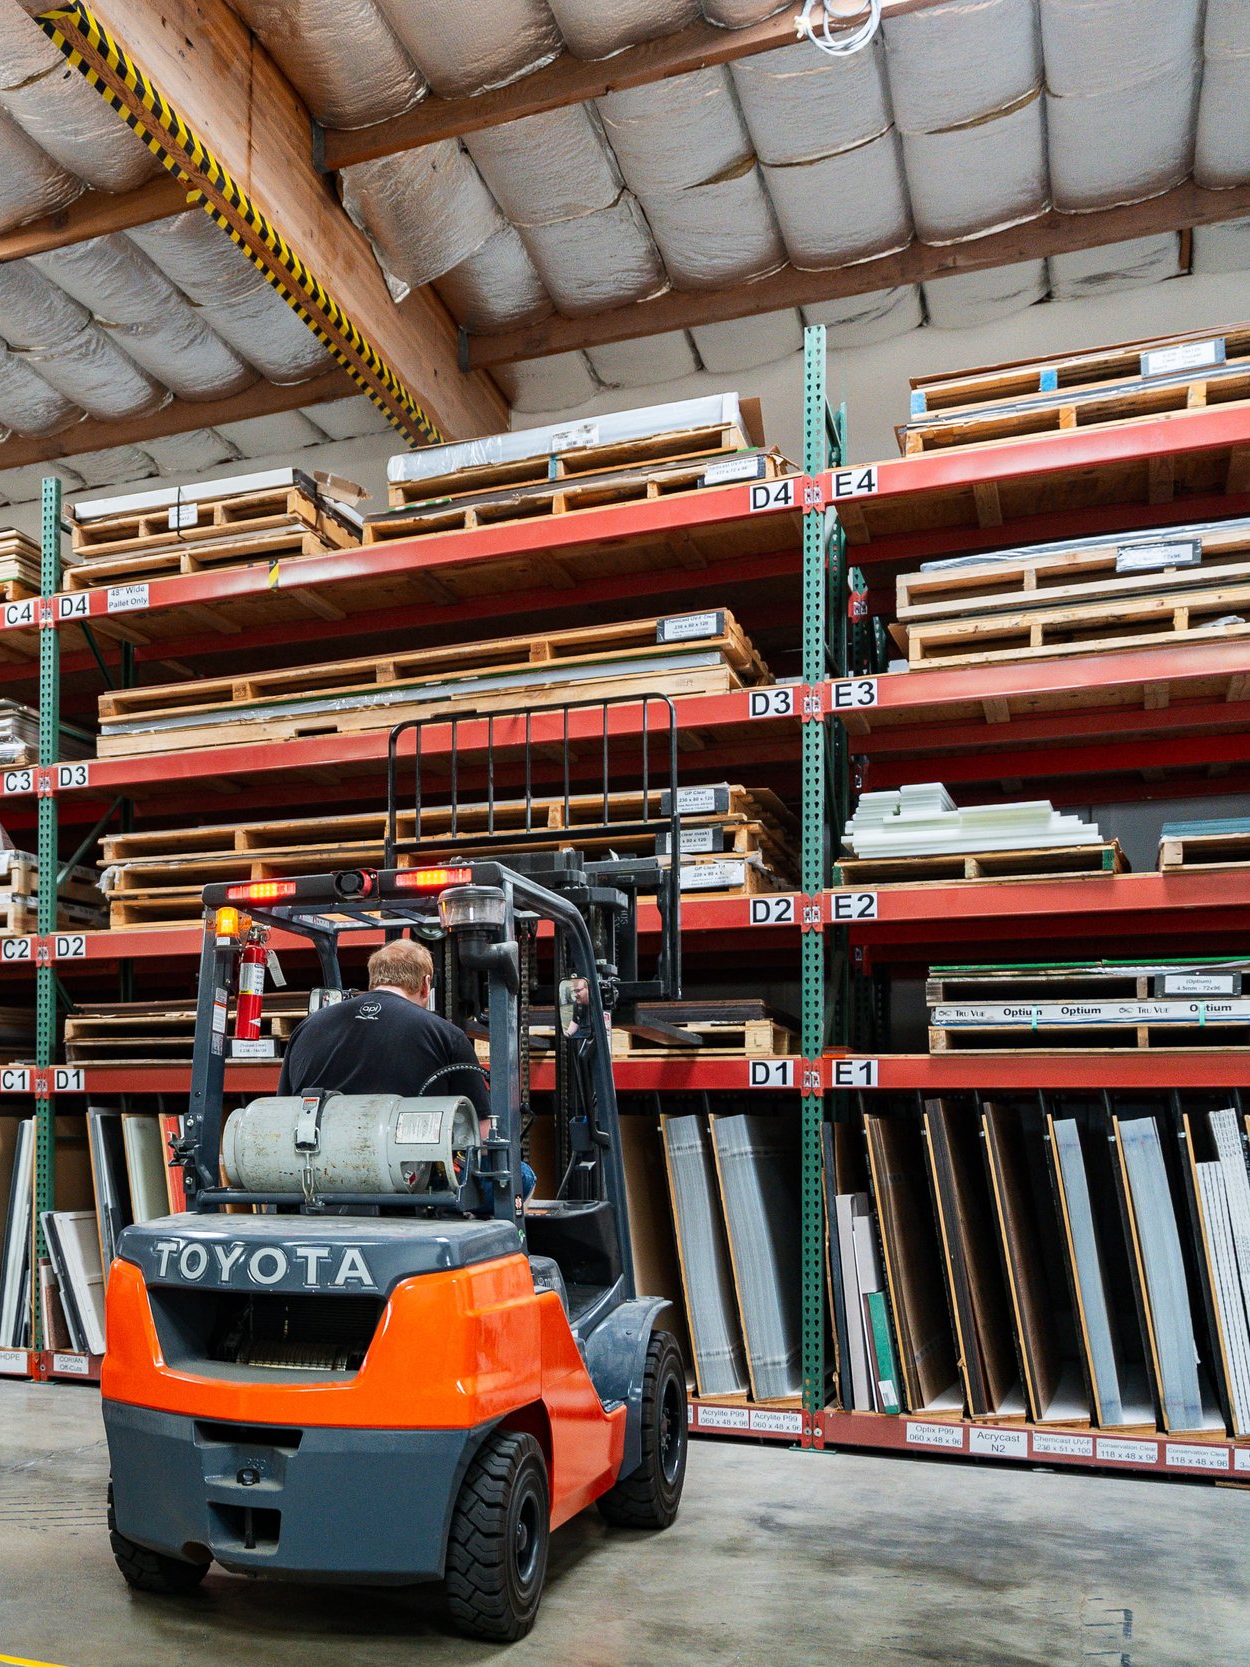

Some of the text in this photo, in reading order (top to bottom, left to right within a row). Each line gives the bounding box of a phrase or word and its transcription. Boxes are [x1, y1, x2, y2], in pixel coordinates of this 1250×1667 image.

[835, 469, 875, 497] E4
[752, 482, 792, 509] D4
[111, 586, 145, 596] 48" Wide
[61, 595, 88, 616] D4
[109, 597, 148, 608] Pallet Only
[6, 604, 32, 624] C4
[752, 691, 791, 717] D3
[836, 681, 875, 708] E3
[5, 773, 31, 792] C3
[60, 766, 87, 787] D3
[753, 899, 792, 923] D2
[835, 894, 875, 919] E2
[3, 940, 29, 959] C2
[57, 937, 84, 957] D2
[1061, 1006, 1101, 1017] Optium
[1190, 1004, 1232, 1013] Otium
[2, 1071, 27, 1090] C1
[56, 1070, 81, 1089] D1
[752, 1062, 787, 1085] D1
[836, 1061, 872, 1085] E1
[155, 1241, 375, 1286] TOYOTA
[0, 1353, 20, 1361] HDPE
[59, 1355, 83, 1364] CORIAN
[59, 1363, 83, 1372] Off-Cuts
[702, 1409, 728, 1417] Acrylite
[754, 1413, 781, 1421] Acrylite
[915, 1425, 954, 1435] Optix P99
[977, 1431, 1020, 1443] Acrycast
[1034, 1435, 1070, 1444] Chemcast
[991, 1445, 1006, 1453] N2
[1098, 1442, 1138, 1450] Conservation
[1168, 1447, 1208, 1456] Conservation
